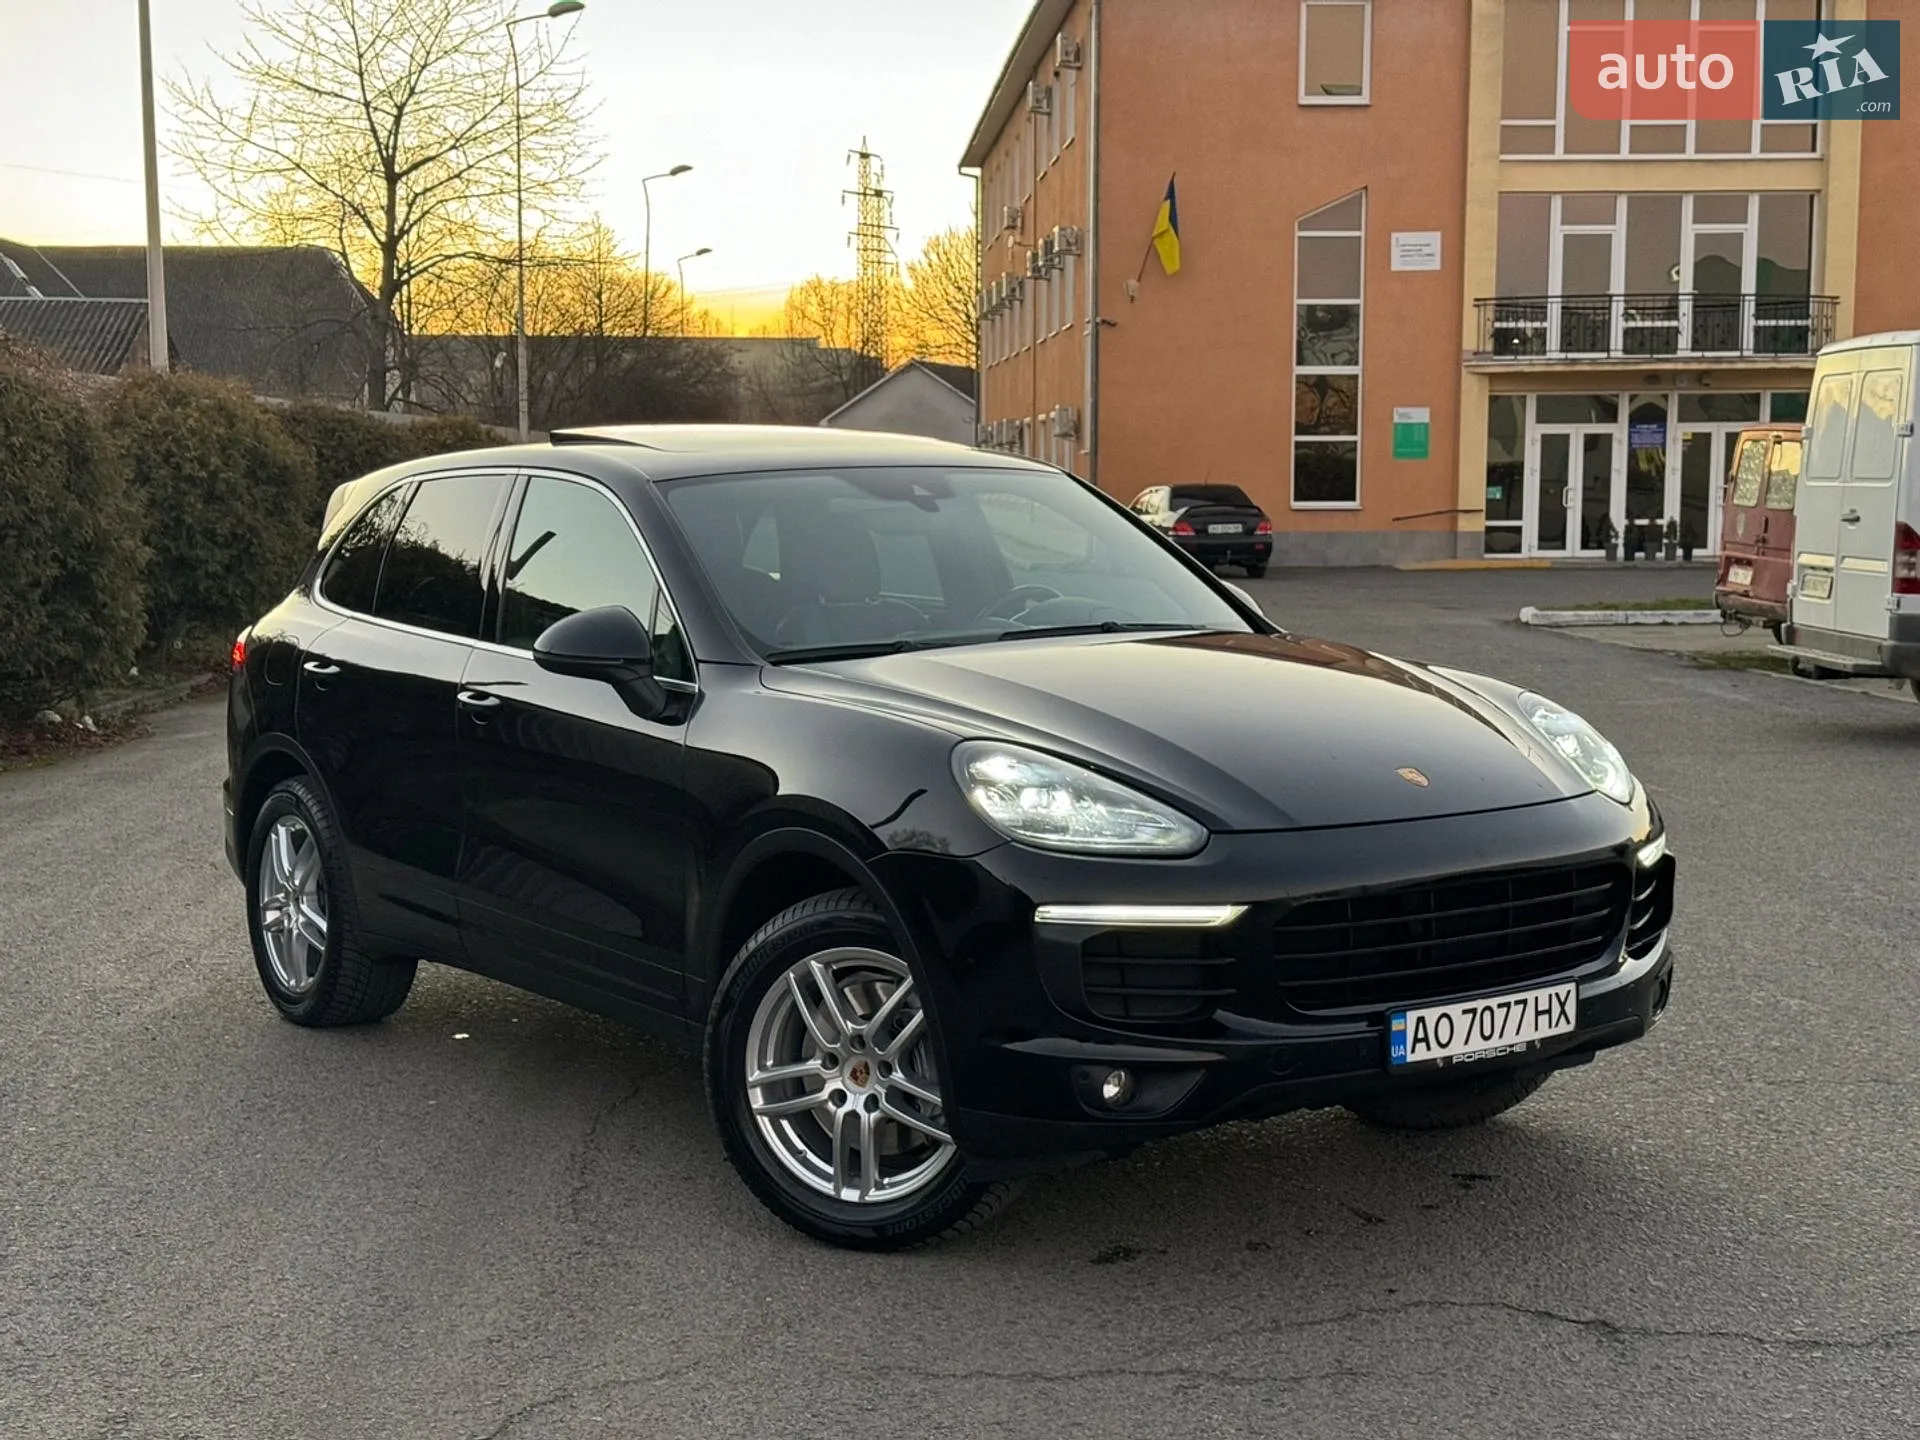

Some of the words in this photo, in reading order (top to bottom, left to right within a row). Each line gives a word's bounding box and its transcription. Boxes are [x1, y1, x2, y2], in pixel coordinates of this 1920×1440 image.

[1410, 1012, 1454, 1055] AO
[1461, 998, 1529, 1046] 7077
[1534, 989, 1572, 1032] HX
[1391, 1044, 1406, 1057] UA
[1452, 1042, 1528, 1065] PORSCHE
